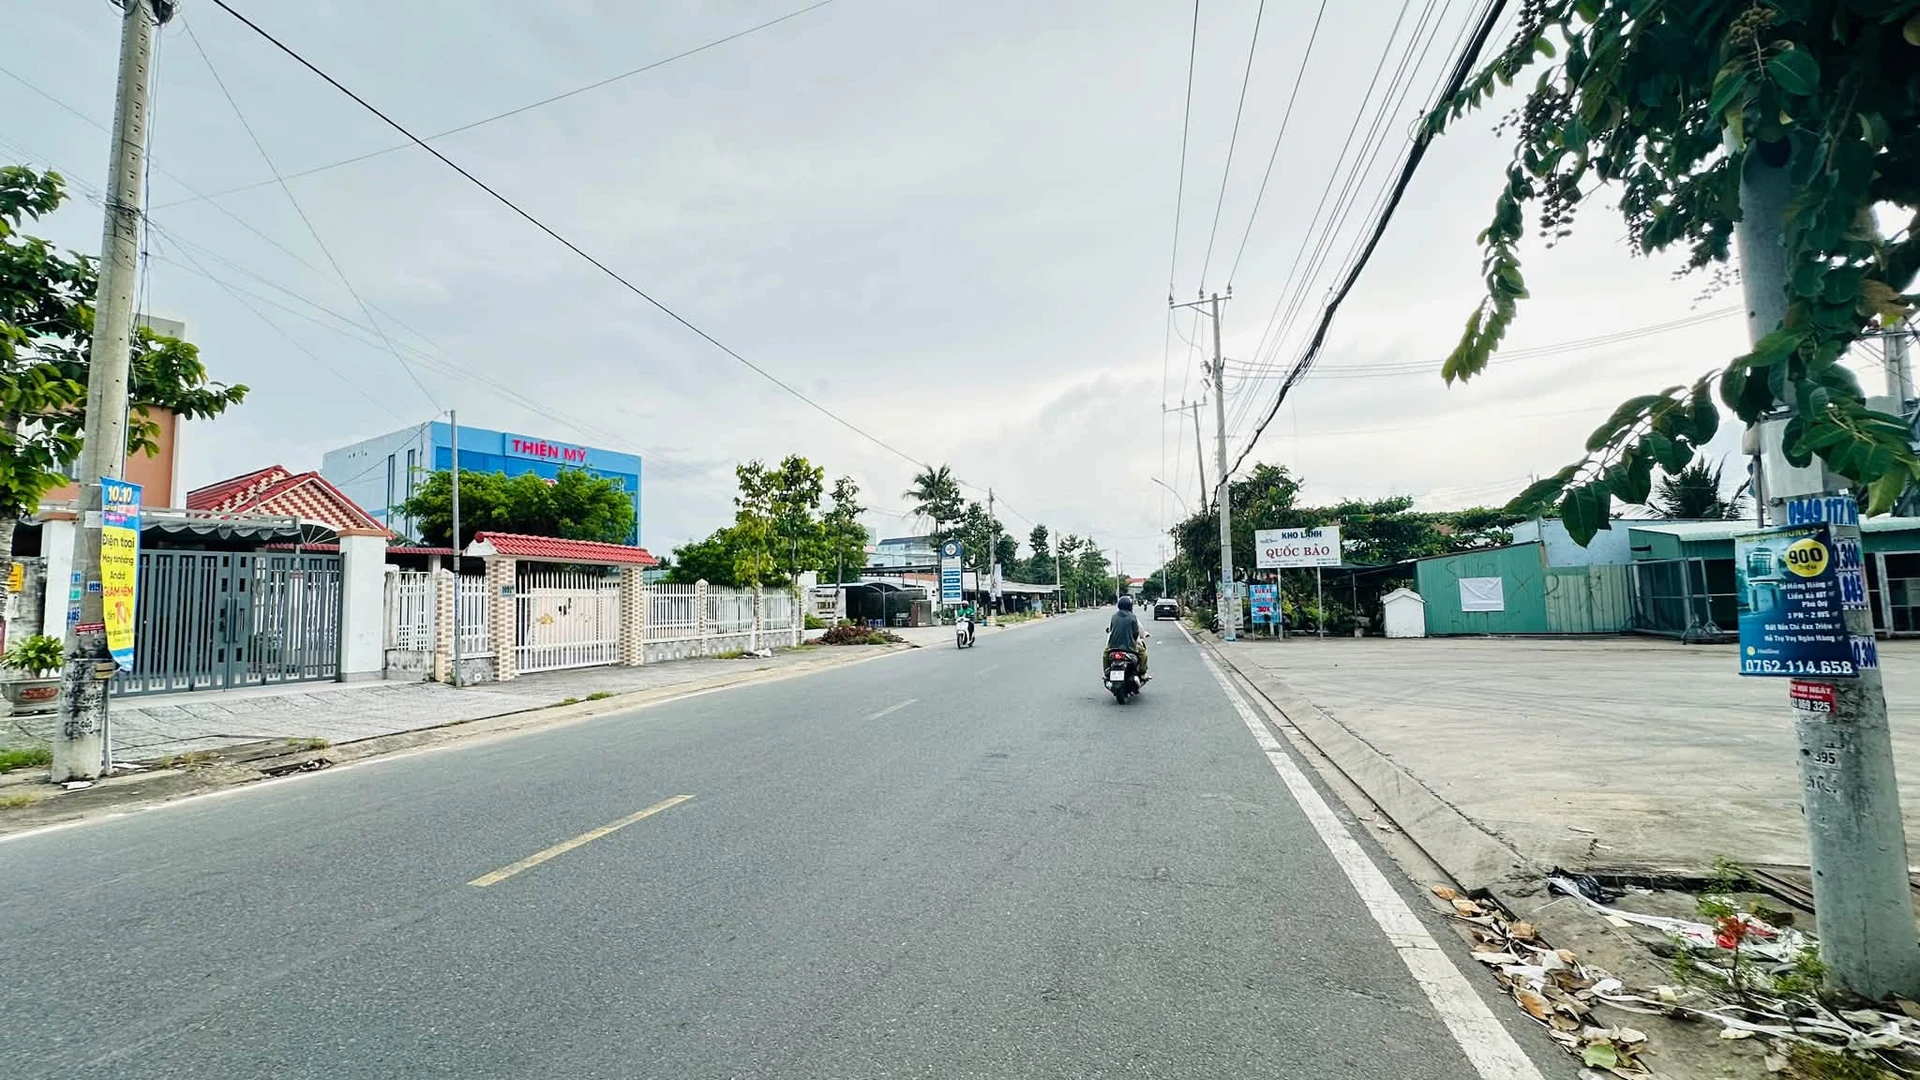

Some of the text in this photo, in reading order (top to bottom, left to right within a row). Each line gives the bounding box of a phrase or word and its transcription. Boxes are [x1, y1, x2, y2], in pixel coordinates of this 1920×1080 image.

[512, 439, 586, 463] THIỆN MỸ
[1788, 498, 1822, 525] 0949
[1282, 531, 1298, 539] KHO
[1266, 543, 1330, 559] QUỐC BẢO
[1788, 547, 1823, 565] 900
[1745, 658, 1853, 674] 0762.114.658
[1812, 700, 1831, 712] 325
